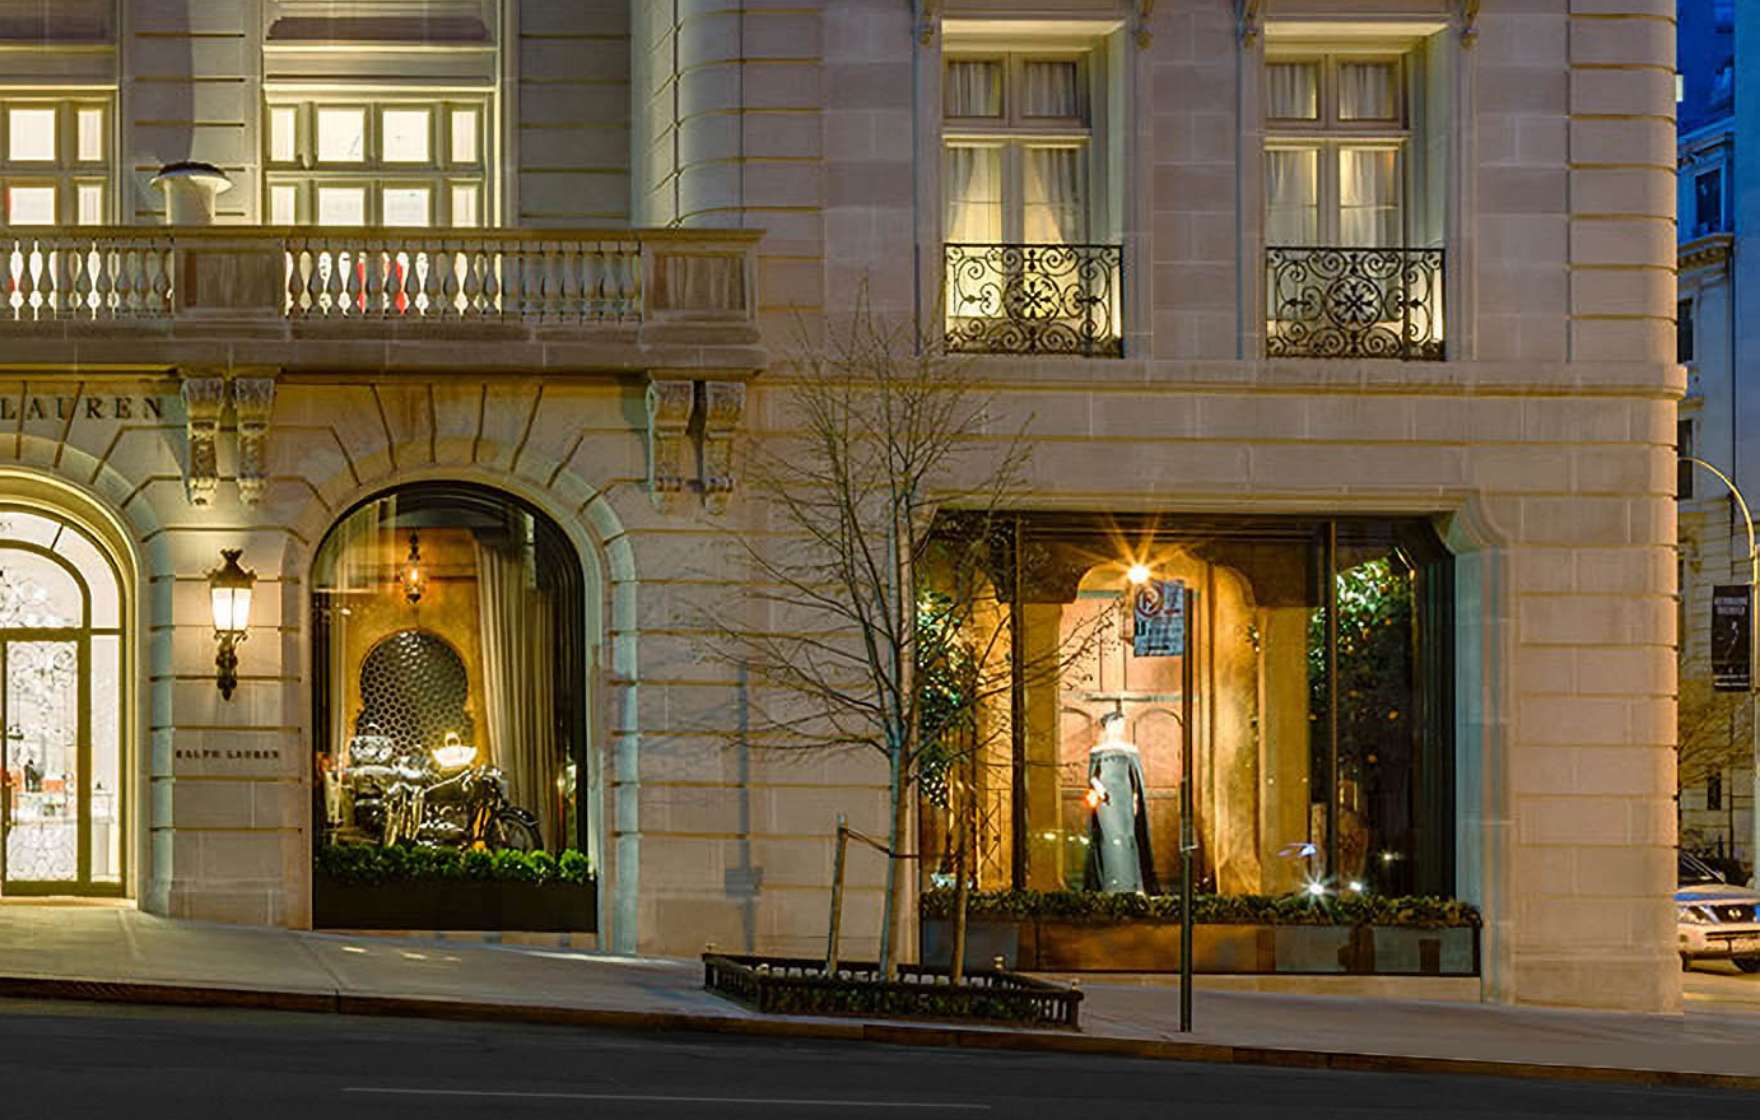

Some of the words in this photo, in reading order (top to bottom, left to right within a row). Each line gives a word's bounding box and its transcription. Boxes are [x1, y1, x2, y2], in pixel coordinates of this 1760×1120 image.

[0, 396, 162, 420] LAUREN
[175, 749, 221, 759] RALPH
[227, 749, 279, 759] LAUREN
